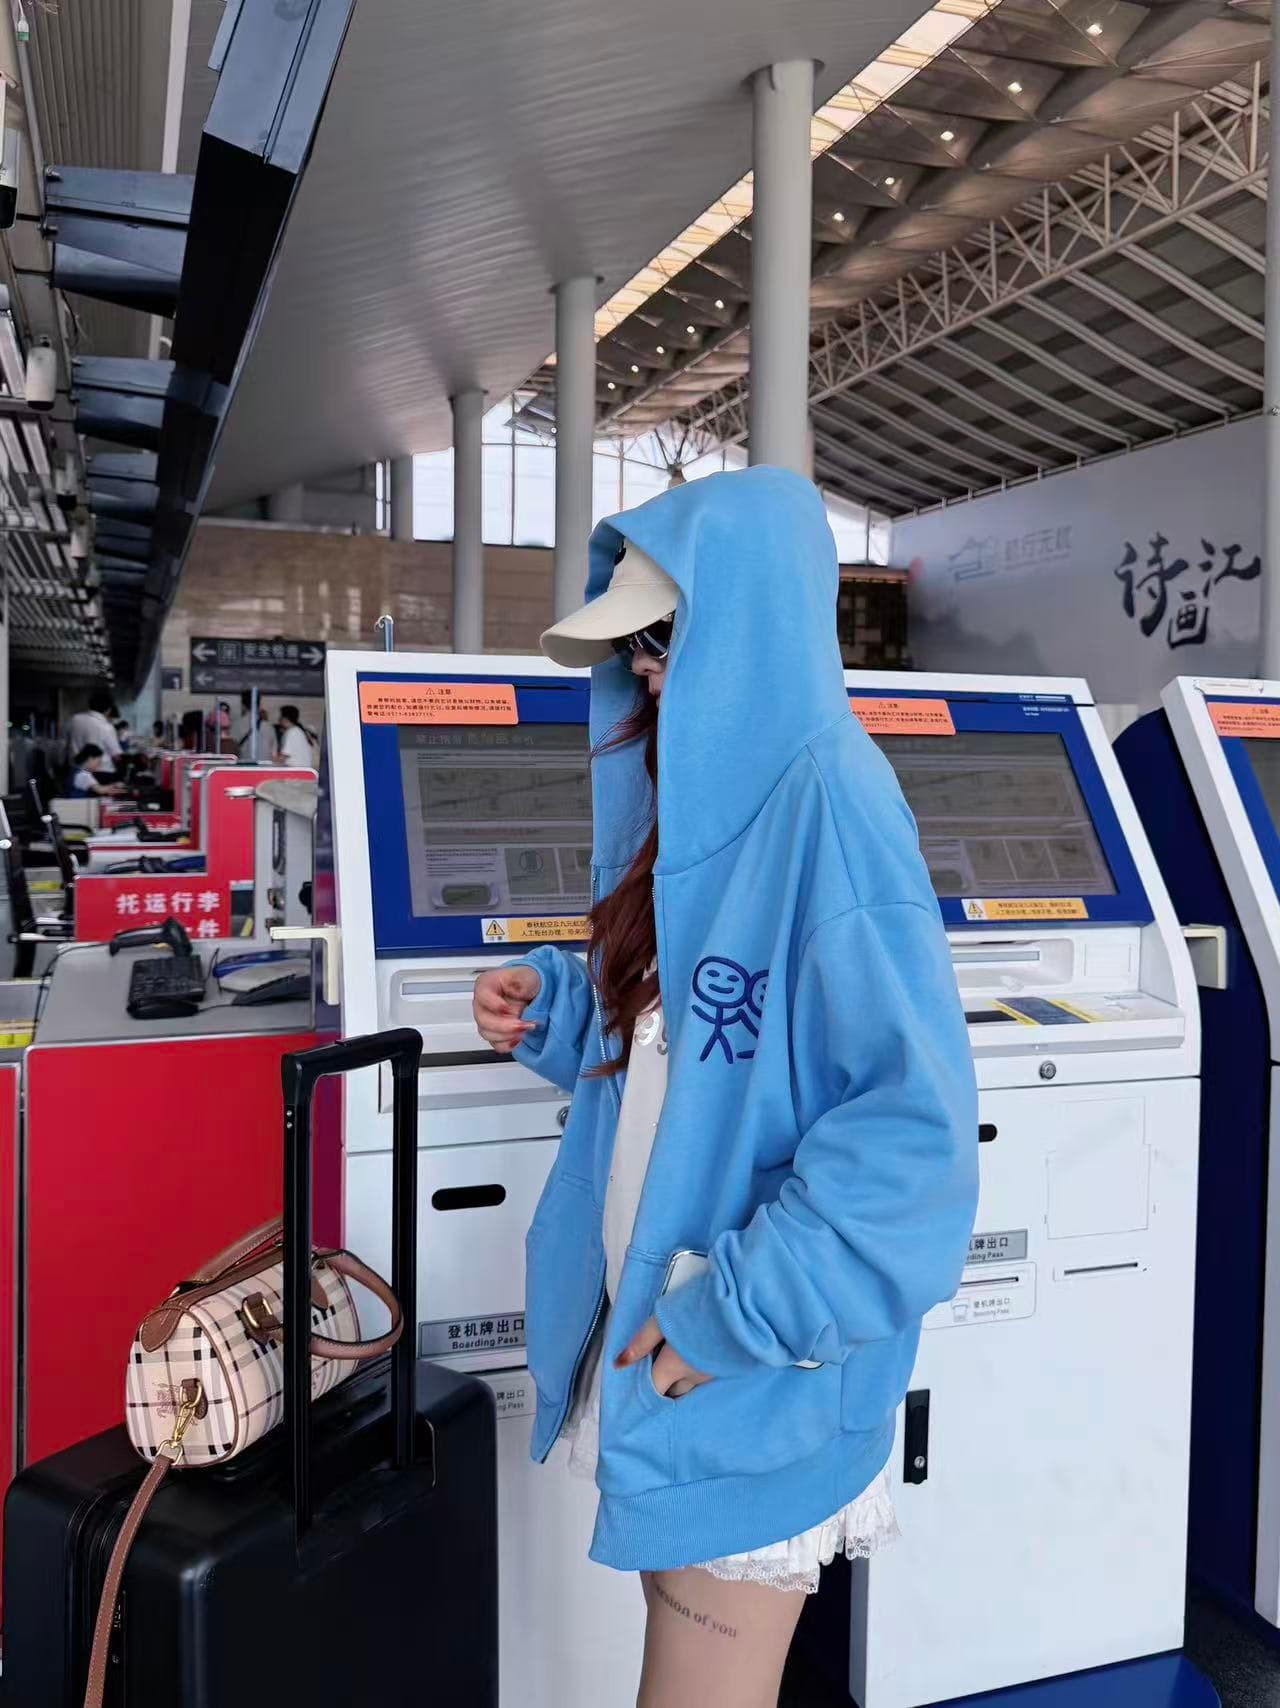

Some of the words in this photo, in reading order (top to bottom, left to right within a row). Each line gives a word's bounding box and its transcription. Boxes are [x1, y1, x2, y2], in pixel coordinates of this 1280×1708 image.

[116, 891, 220, 914] 托运行李
[448, 1319, 525, 1340] 登机牌出口
[451, 1338, 496, 1350] Boarding
[497, 1335, 519, 1346] Pass
[710, 1620, 737, 1640] you
